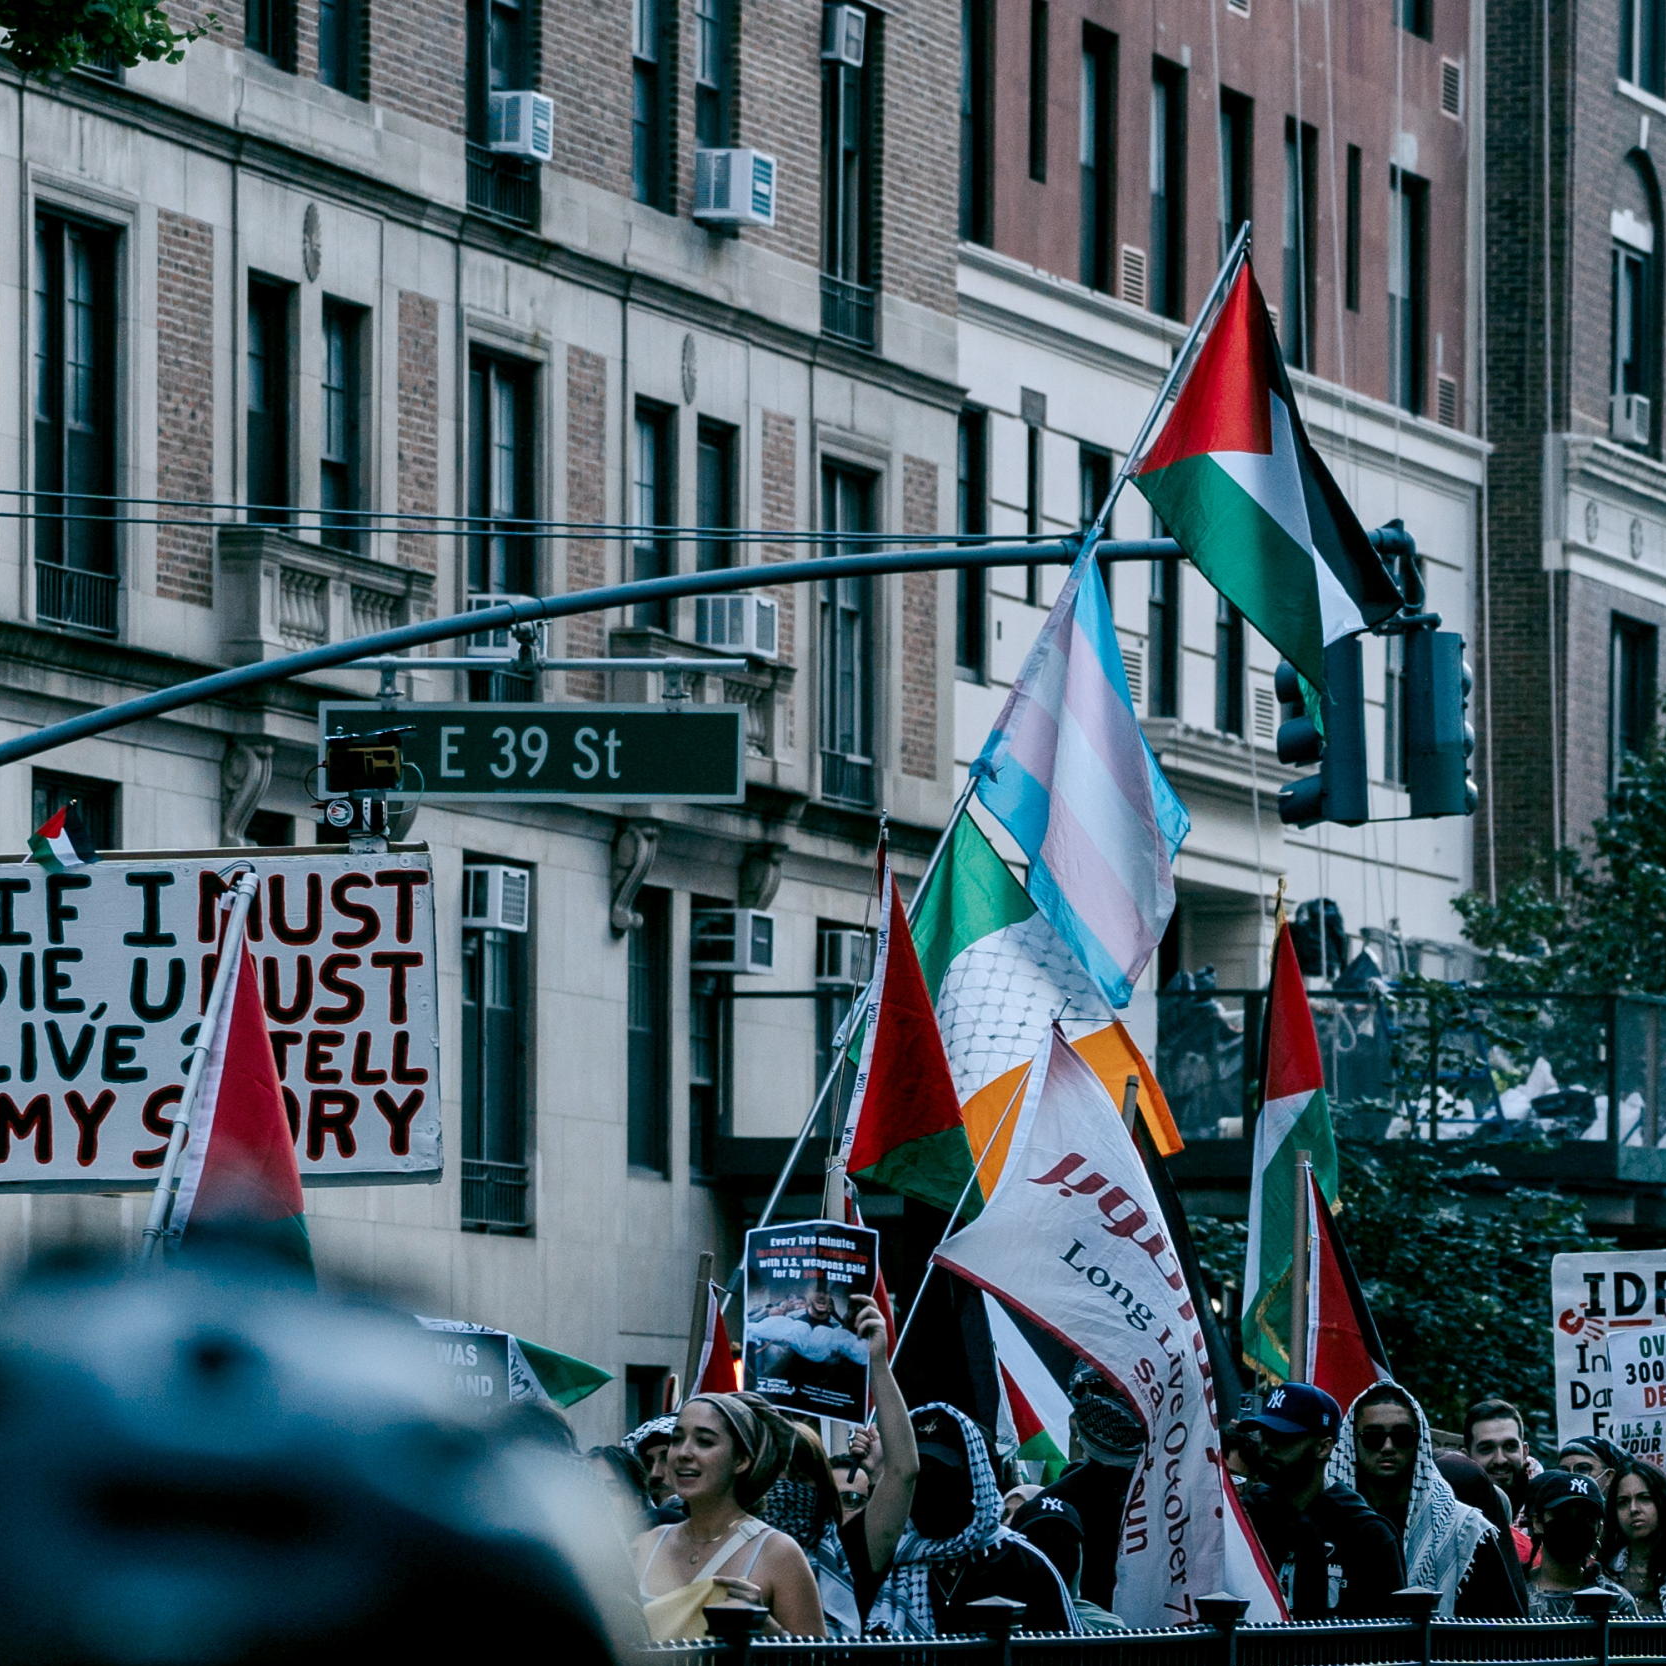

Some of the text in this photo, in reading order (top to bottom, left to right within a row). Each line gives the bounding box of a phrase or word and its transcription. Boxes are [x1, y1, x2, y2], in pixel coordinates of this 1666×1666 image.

[440, 725, 622, 780] E 39 St
[124, 871, 176, 947] I
[130, 956, 186, 1025] U
[770, 1236, 857, 1250] Every two minutes
[759, 1257, 867, 1275] with U.S. weapons paid
[773, 1269, 786, 1278] for
[788, 1268, 801, 1279] by
[826, 1271, 853, 1283] taxes
[1059, 1238, 1157, 1331] Long
[1155, 1323, 1185, 1416] Live
[1621, 1422, 1647, 1439] U.S.
[1653, 1420, 1662, 1435] &
[1622, 1437, 1661, 1454] YOUR
